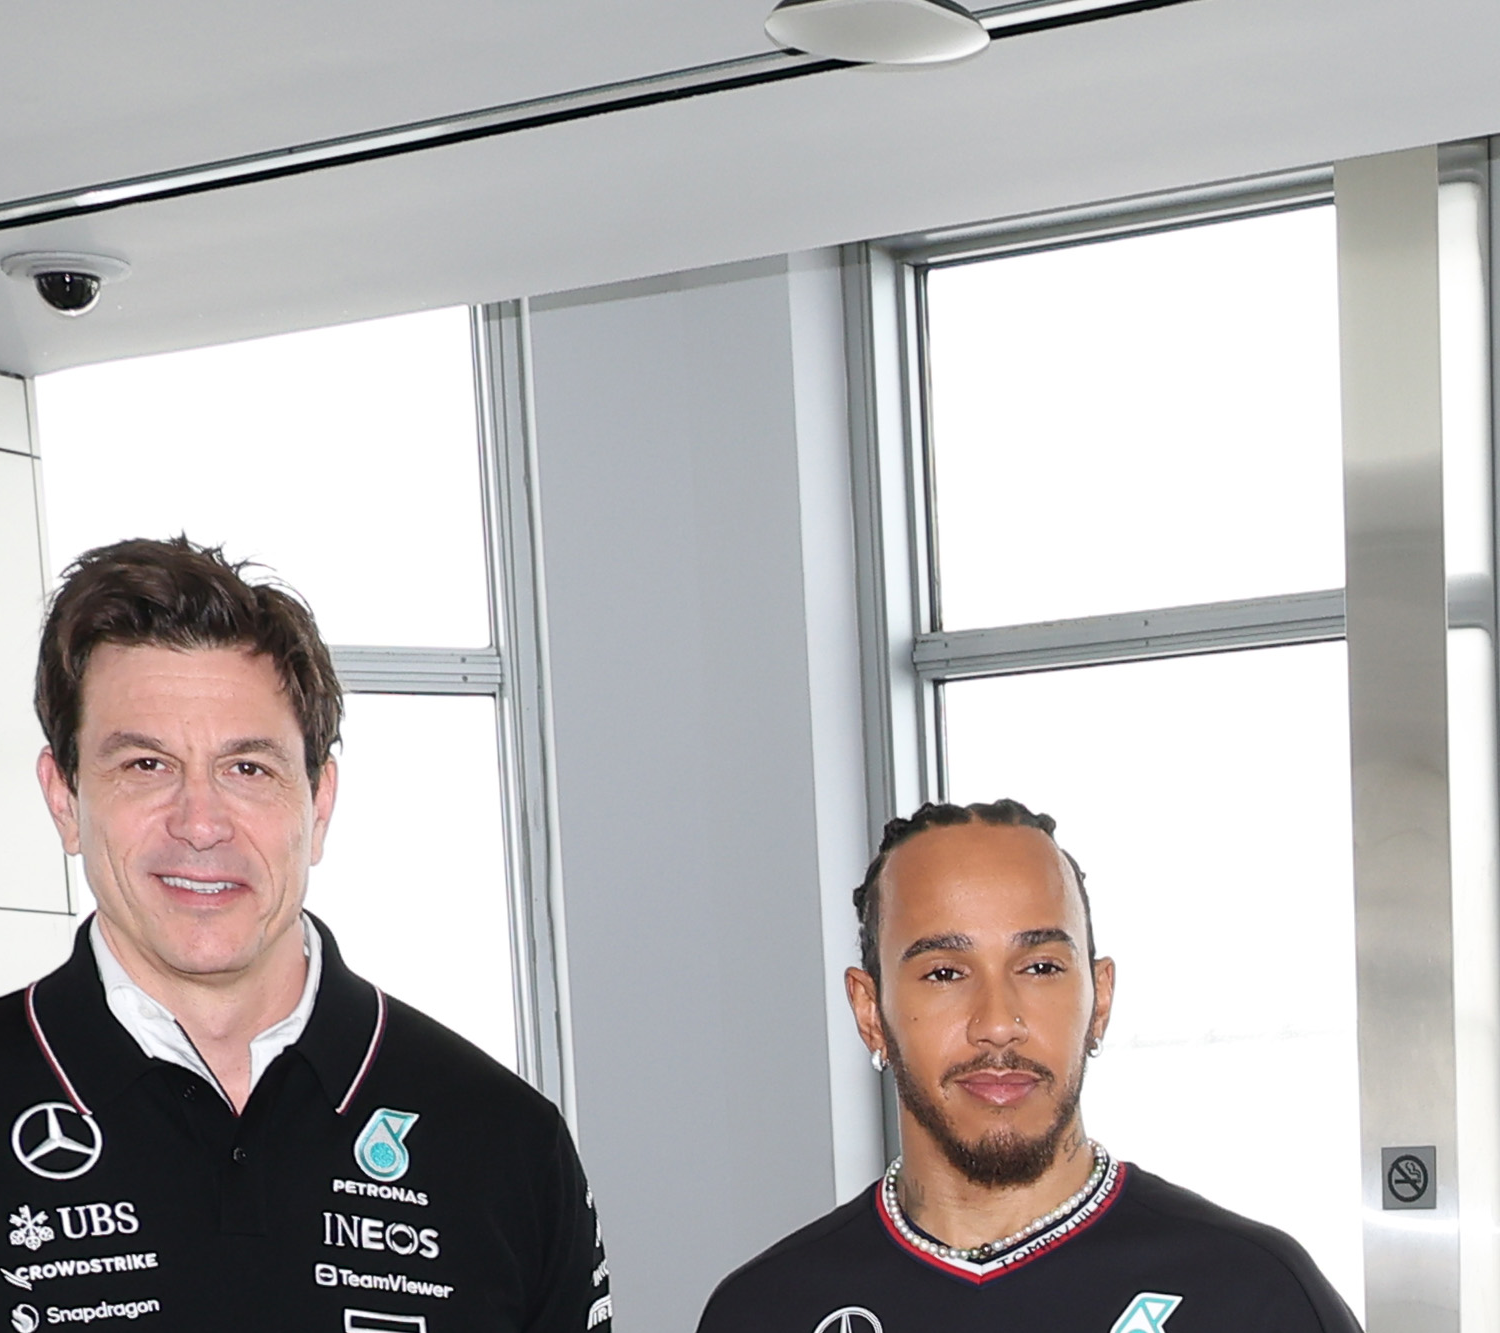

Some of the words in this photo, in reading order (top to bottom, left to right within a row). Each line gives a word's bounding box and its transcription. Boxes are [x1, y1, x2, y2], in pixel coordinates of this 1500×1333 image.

[332, 1179, 429, 1206] PETRONAS
[56, 1201, 140, 1240] UBS
[322, 1211, 440, 1260] INEOS
[15, 1252, 159, 1284] CROWDSTRIKE
[339, 1268, 453, 1300] TeamViewer
[46, 1299, 160, 1327] Snapdragon
